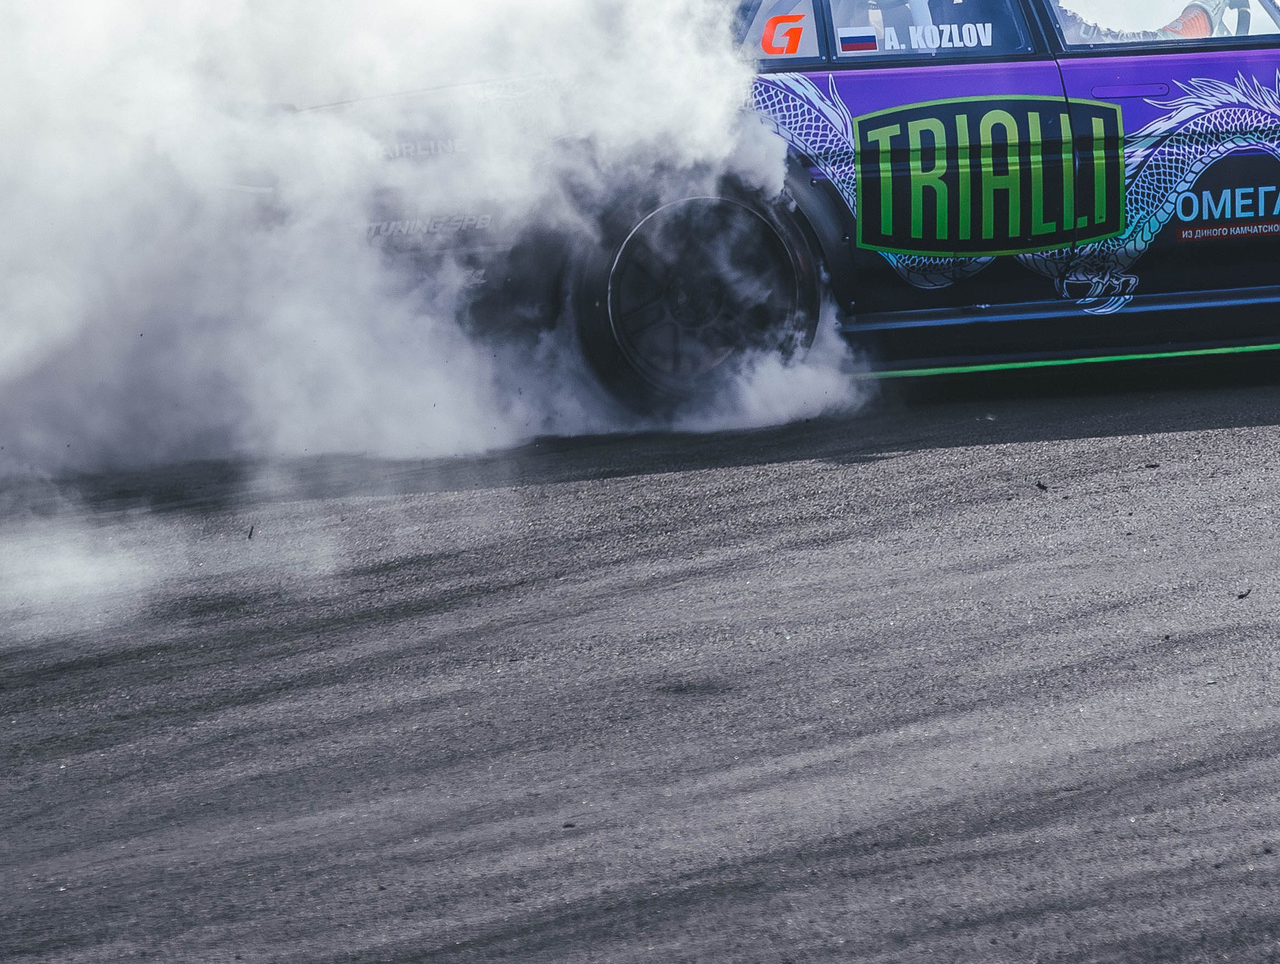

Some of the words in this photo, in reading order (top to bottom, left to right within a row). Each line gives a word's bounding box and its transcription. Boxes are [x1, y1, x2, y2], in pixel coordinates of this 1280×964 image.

[884, 25, 906, 51] A.
[911, 22, 993, 49] KOZLOV
[866, 109, 1108, 242] TRIALLI
[1182, 229, 1193, 239] ИЗ
[1194, 227, 1229, 239] ДИКОГО
